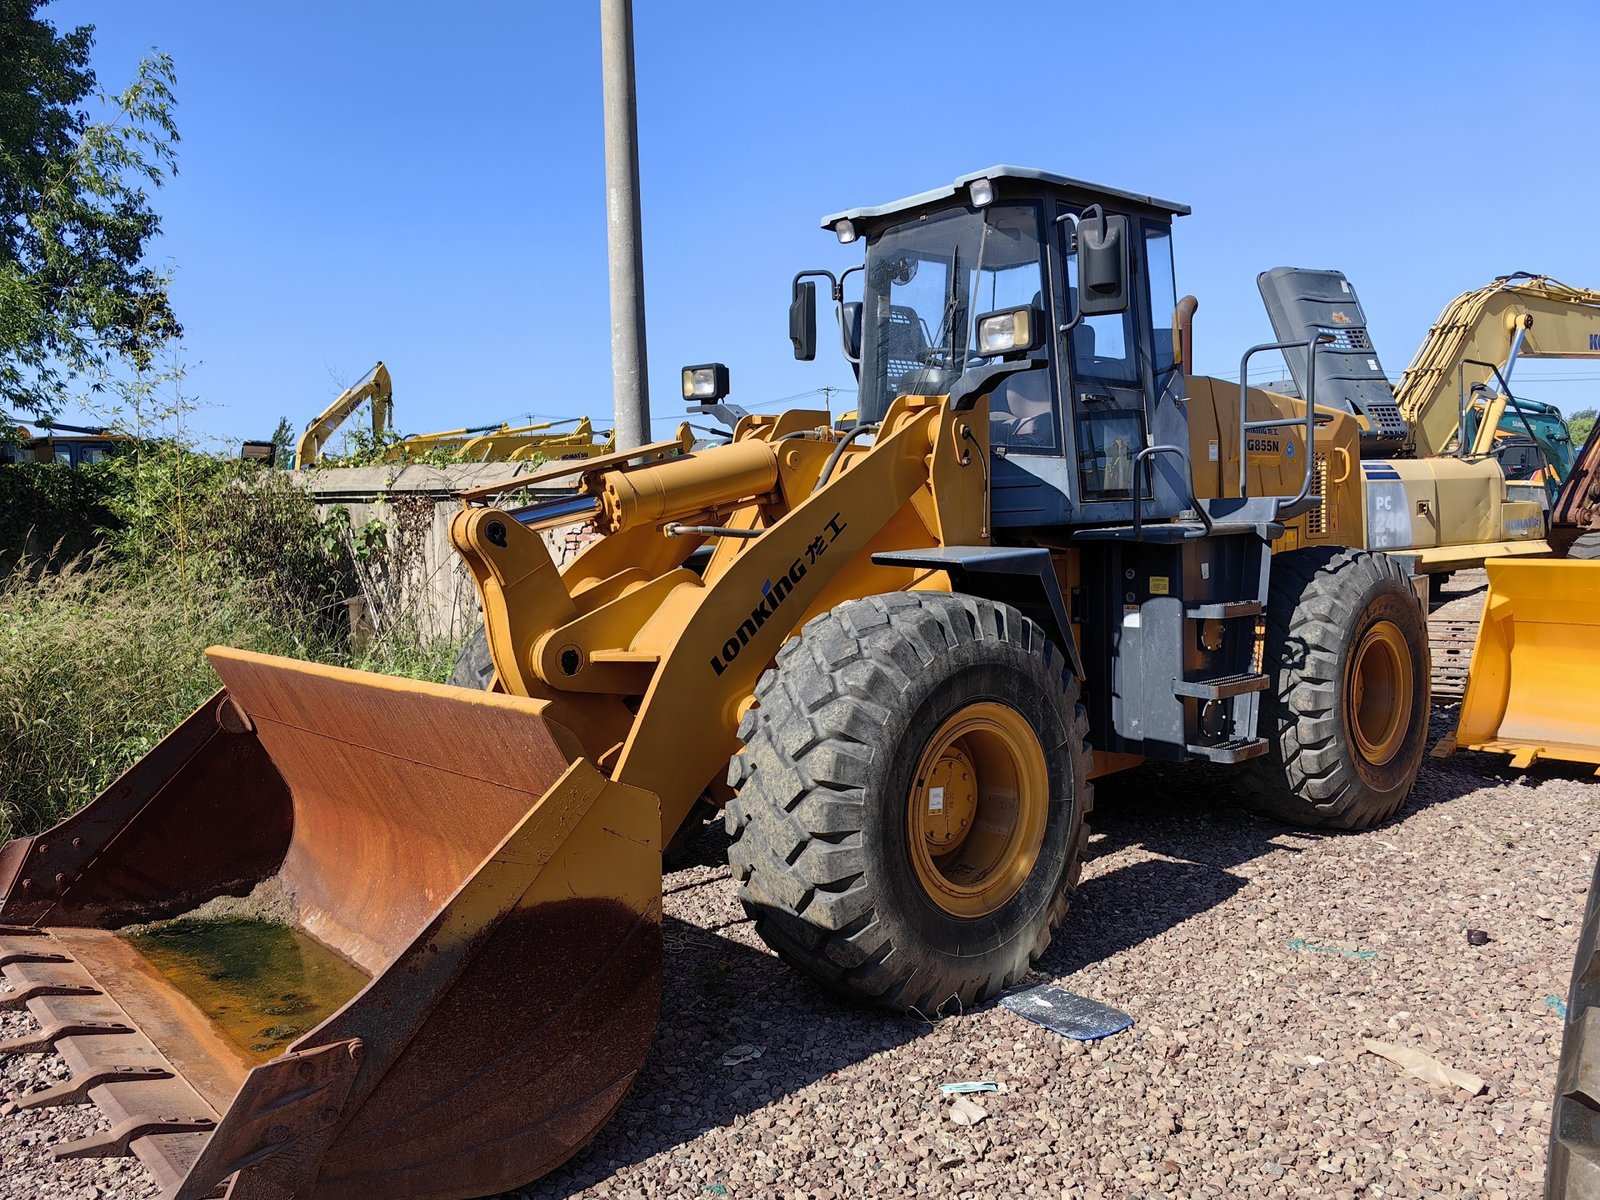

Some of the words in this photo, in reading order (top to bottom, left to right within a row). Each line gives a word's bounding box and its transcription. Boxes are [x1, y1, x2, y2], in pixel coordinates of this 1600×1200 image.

[1376, 495, 1391, 511] PC
[1375, 511, 1405, 533] 240
[1375, 535, 1387, 547] LC
